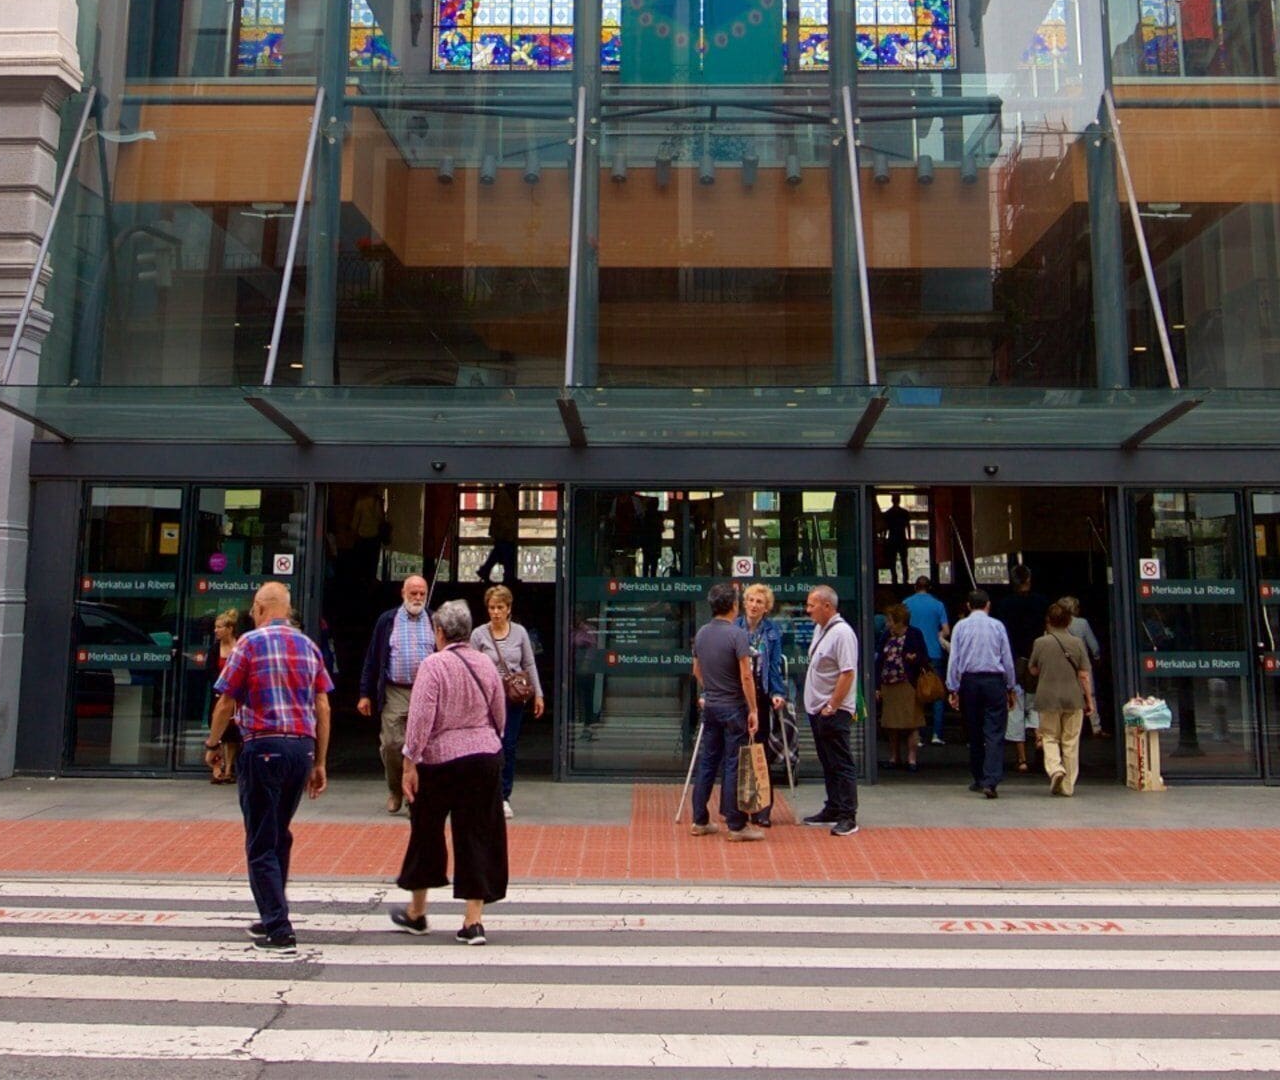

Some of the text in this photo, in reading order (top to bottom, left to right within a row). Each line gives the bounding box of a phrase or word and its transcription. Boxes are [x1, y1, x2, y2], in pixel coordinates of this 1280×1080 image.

[93, 580, 133, 589] Merkatua
[135, 580, 145, 589] La
[148, 580, 175, 589] Ribera
[208, 581, 249, 590] Merkatua
[620, 582, 659, 591] Merkatua
[662, 582, 672, 591] La
[674, 582, 702, 591] Ribera
[784, 582, 795, 592] La
[1152, 585, 1192, 595] Merkatua
[1194, 585, 1204, 595] La
[1207, 585, 1235, 595] Ribera
[88, 651, 128, 661] Merkatua
[131, 651, 141, 661] La
[143, 651, 171, 661] Ribera
[618, 655, 658, 665] Merkatua
[660, 655, 671, 665] La
[1156, 659, 1196, 669] Merkatua
[1198, 659, 1209, 669] La
[1211, 659, 1240, 669] Ribera
